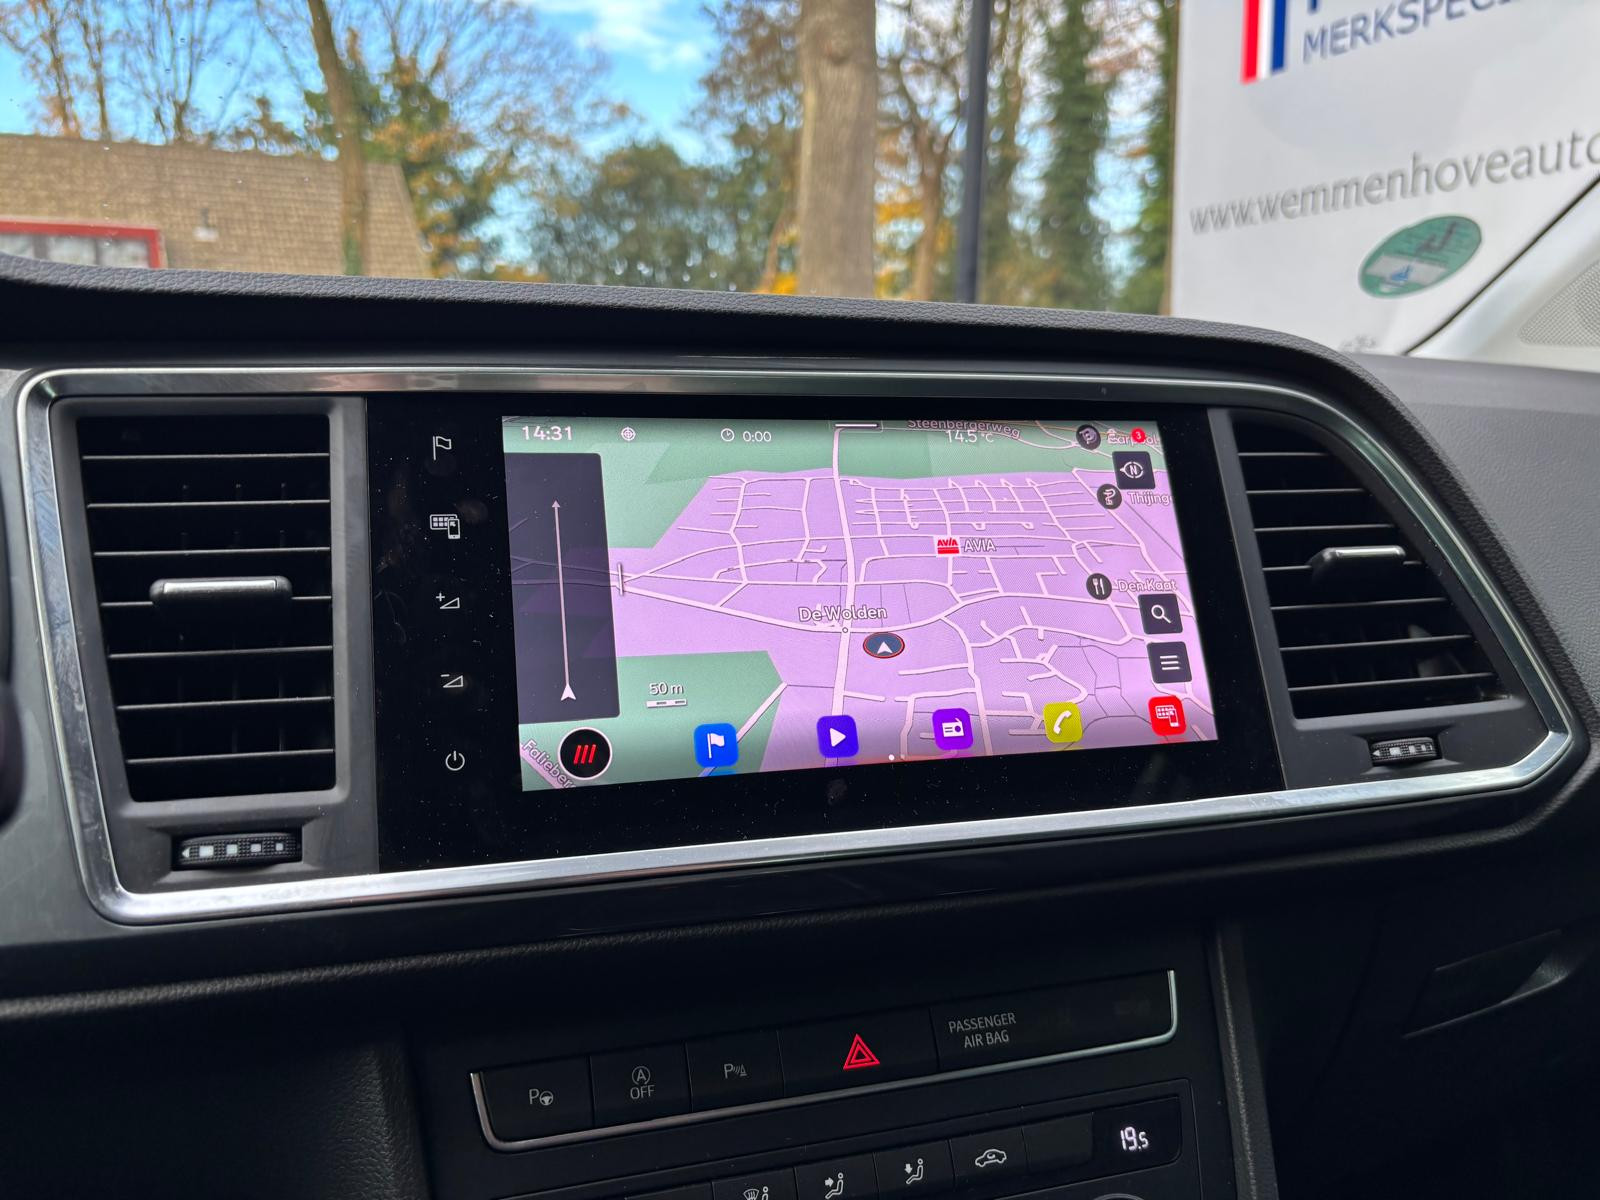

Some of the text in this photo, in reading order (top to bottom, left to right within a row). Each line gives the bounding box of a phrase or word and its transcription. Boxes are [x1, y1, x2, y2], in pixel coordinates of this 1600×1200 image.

[1302, 0, 1512, 63] MERKSPE
[521, 425, 573, 441] 14:31
[742, 431, 772, 442] 0:00
[908, 420, 1021, 439] Steenbergerweg
[946, 429, 978, 443] 14.5
[1127, 491, 1172, 506] Thijing
[963, 539, 997, 552] AVIA
[1118, 580, 1144, 592] Den
[799, 605, 888, 622] De Wolden
[649, 682, 684, 695] 50 m
[522, 739, 576, 788] Falieber
[948, 1012, 1017, 1033] PASSENGER
[964, 1029, 1010, 1048] AIR BAG
[630, 1084, 655, 1100] OFF
[1120, 1126, 1149, 1151] 19.5
